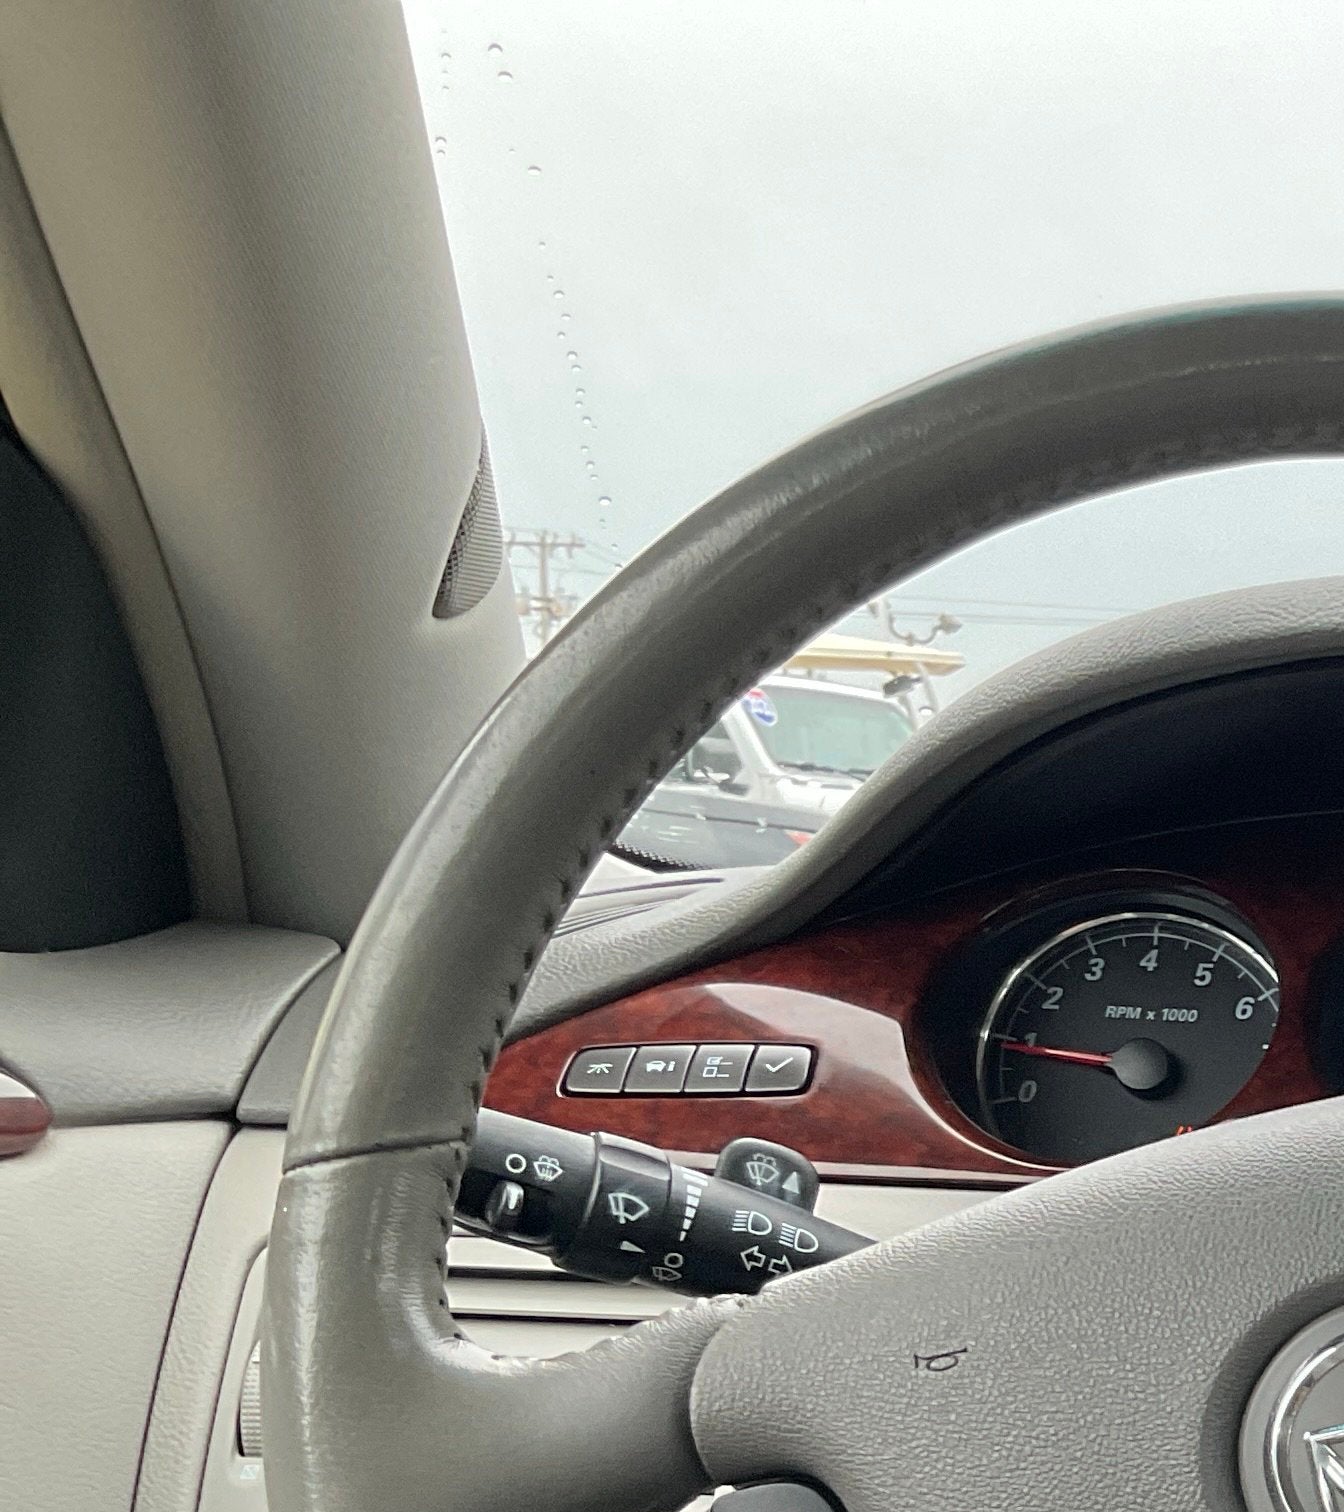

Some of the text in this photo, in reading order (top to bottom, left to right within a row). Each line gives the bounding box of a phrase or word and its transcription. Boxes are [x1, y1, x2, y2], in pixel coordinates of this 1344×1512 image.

[1083, 957, 1106, 982] 3
[1138, 949, 1160, 972] 4
[1193, 962, 1215, 987] 5
[1041, 986, 1065, 1010] 2
[1234, 996, 1256, 1020] 6
[1104, 1005, 1142, 1019] RPM
[1161, 1007, 1199, 1023] 1000
[1017, 1080, 1038, 1103] 0
